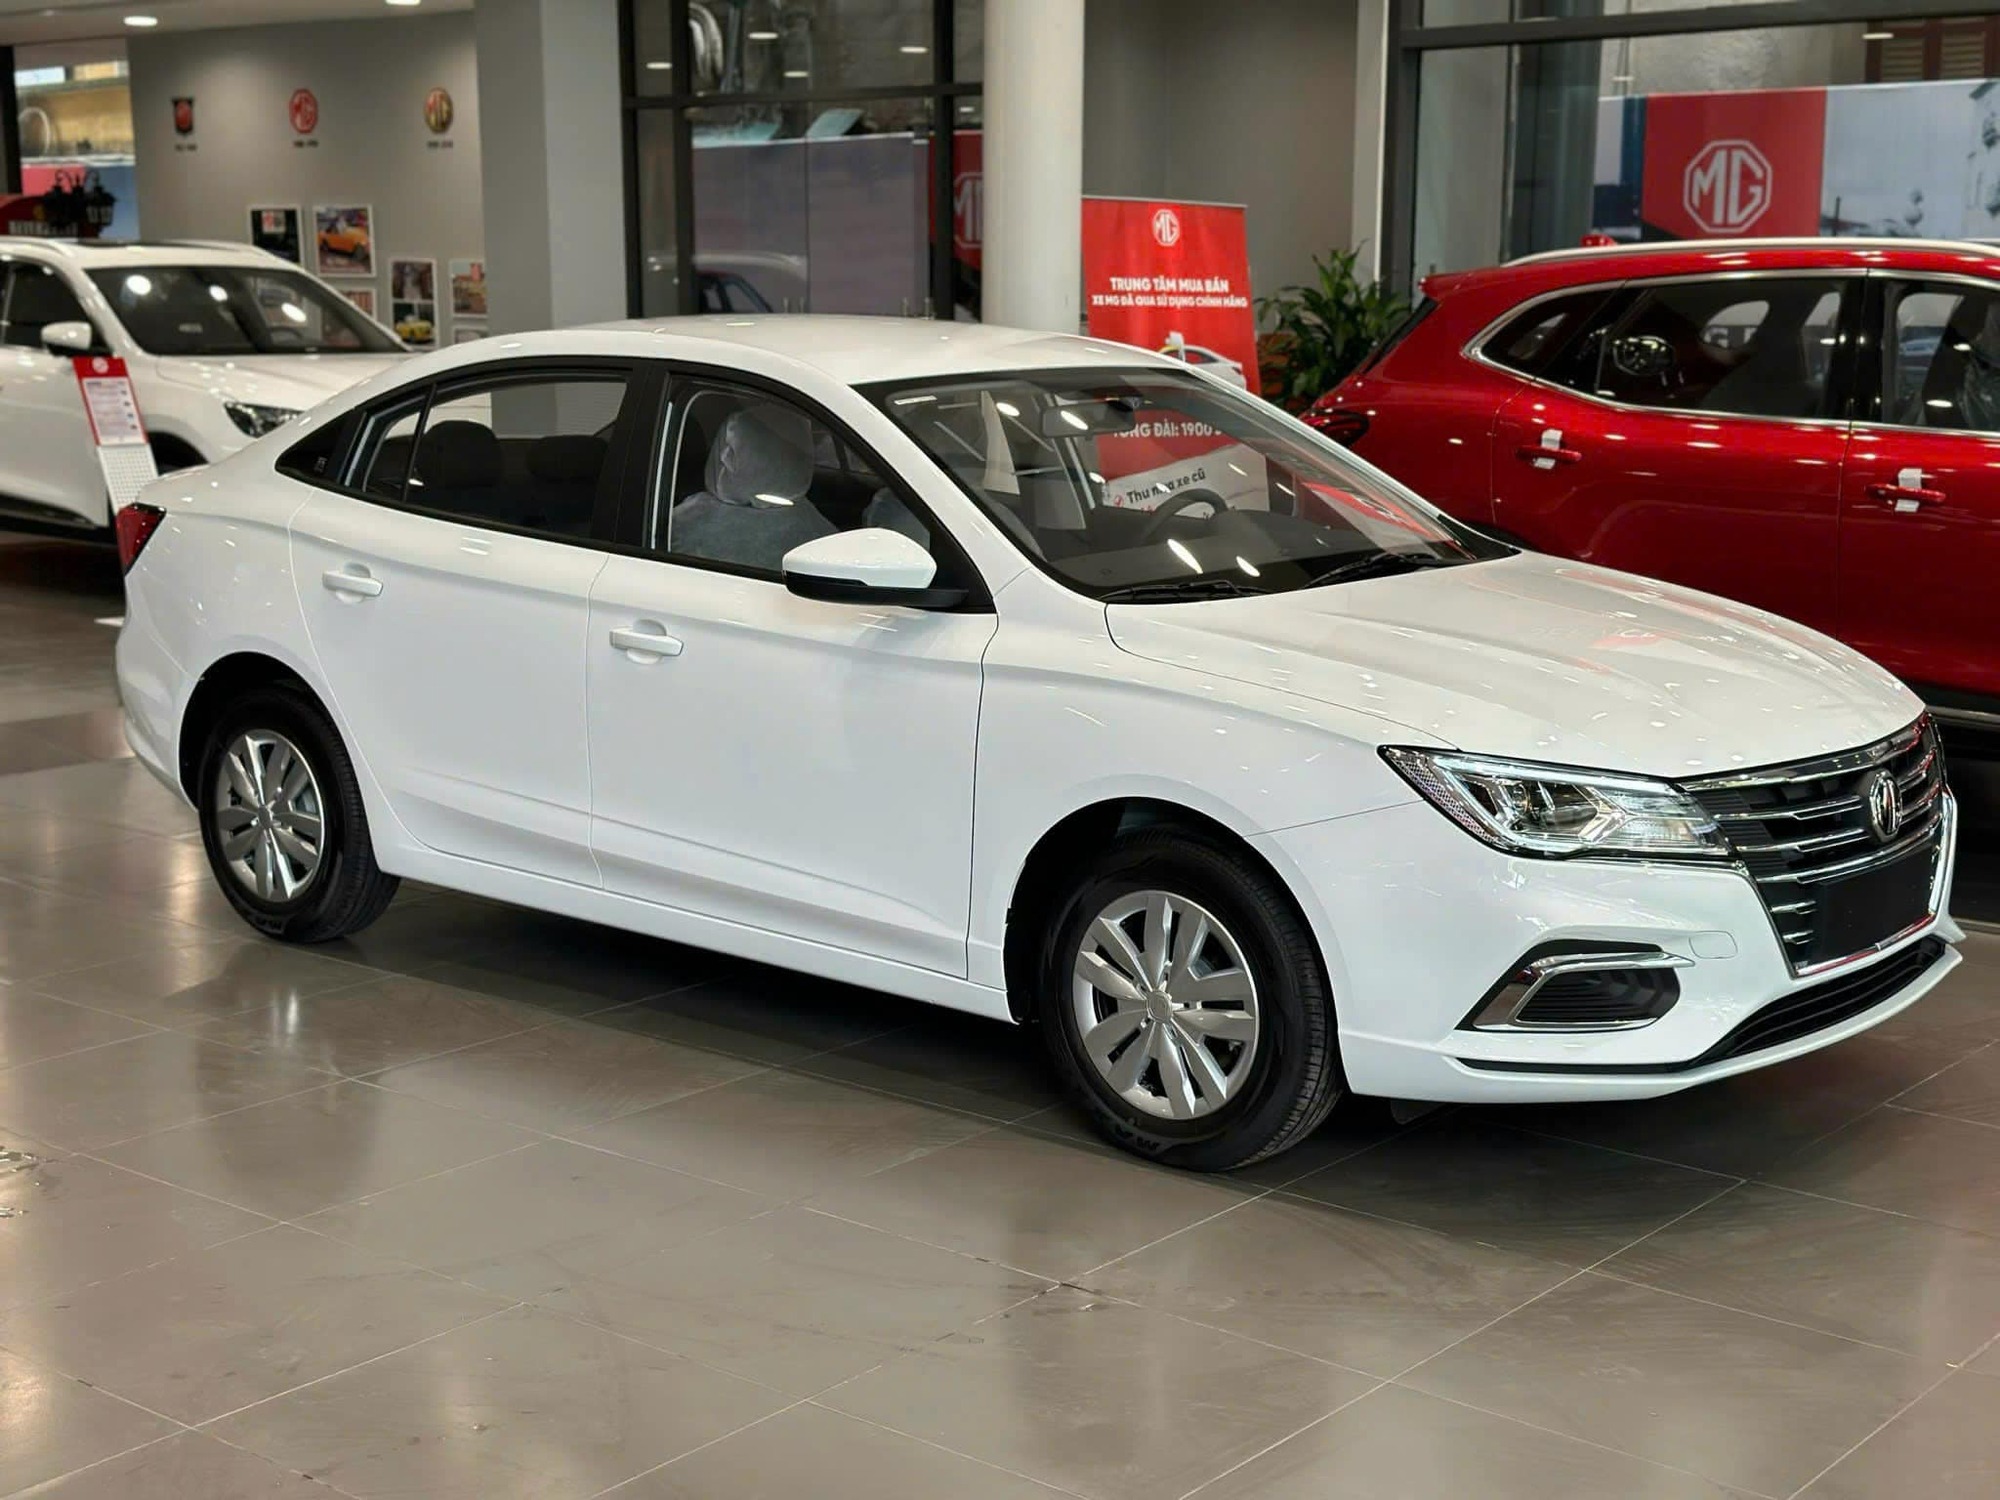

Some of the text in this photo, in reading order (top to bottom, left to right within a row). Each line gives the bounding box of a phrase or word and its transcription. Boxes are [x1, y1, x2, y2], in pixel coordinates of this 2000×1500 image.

[1690, 146, 1765, 226] MG
[953, 177, 983, 243] M
[1153, 210, 1180, 246] MG
[1109, 275, 1229, 293] TRUNG TÂM MUA BÁN
[1135, 295, 1155, 306] QUA
[1153, 418, 1179, 437] ĐÀI:
[1181, 421, 1213, 437] 1900
[1127, 489, 1150, 503] Thu
[1177, 475, 1190, 487] xe
[1191, 467, 1206, 482] cũ
